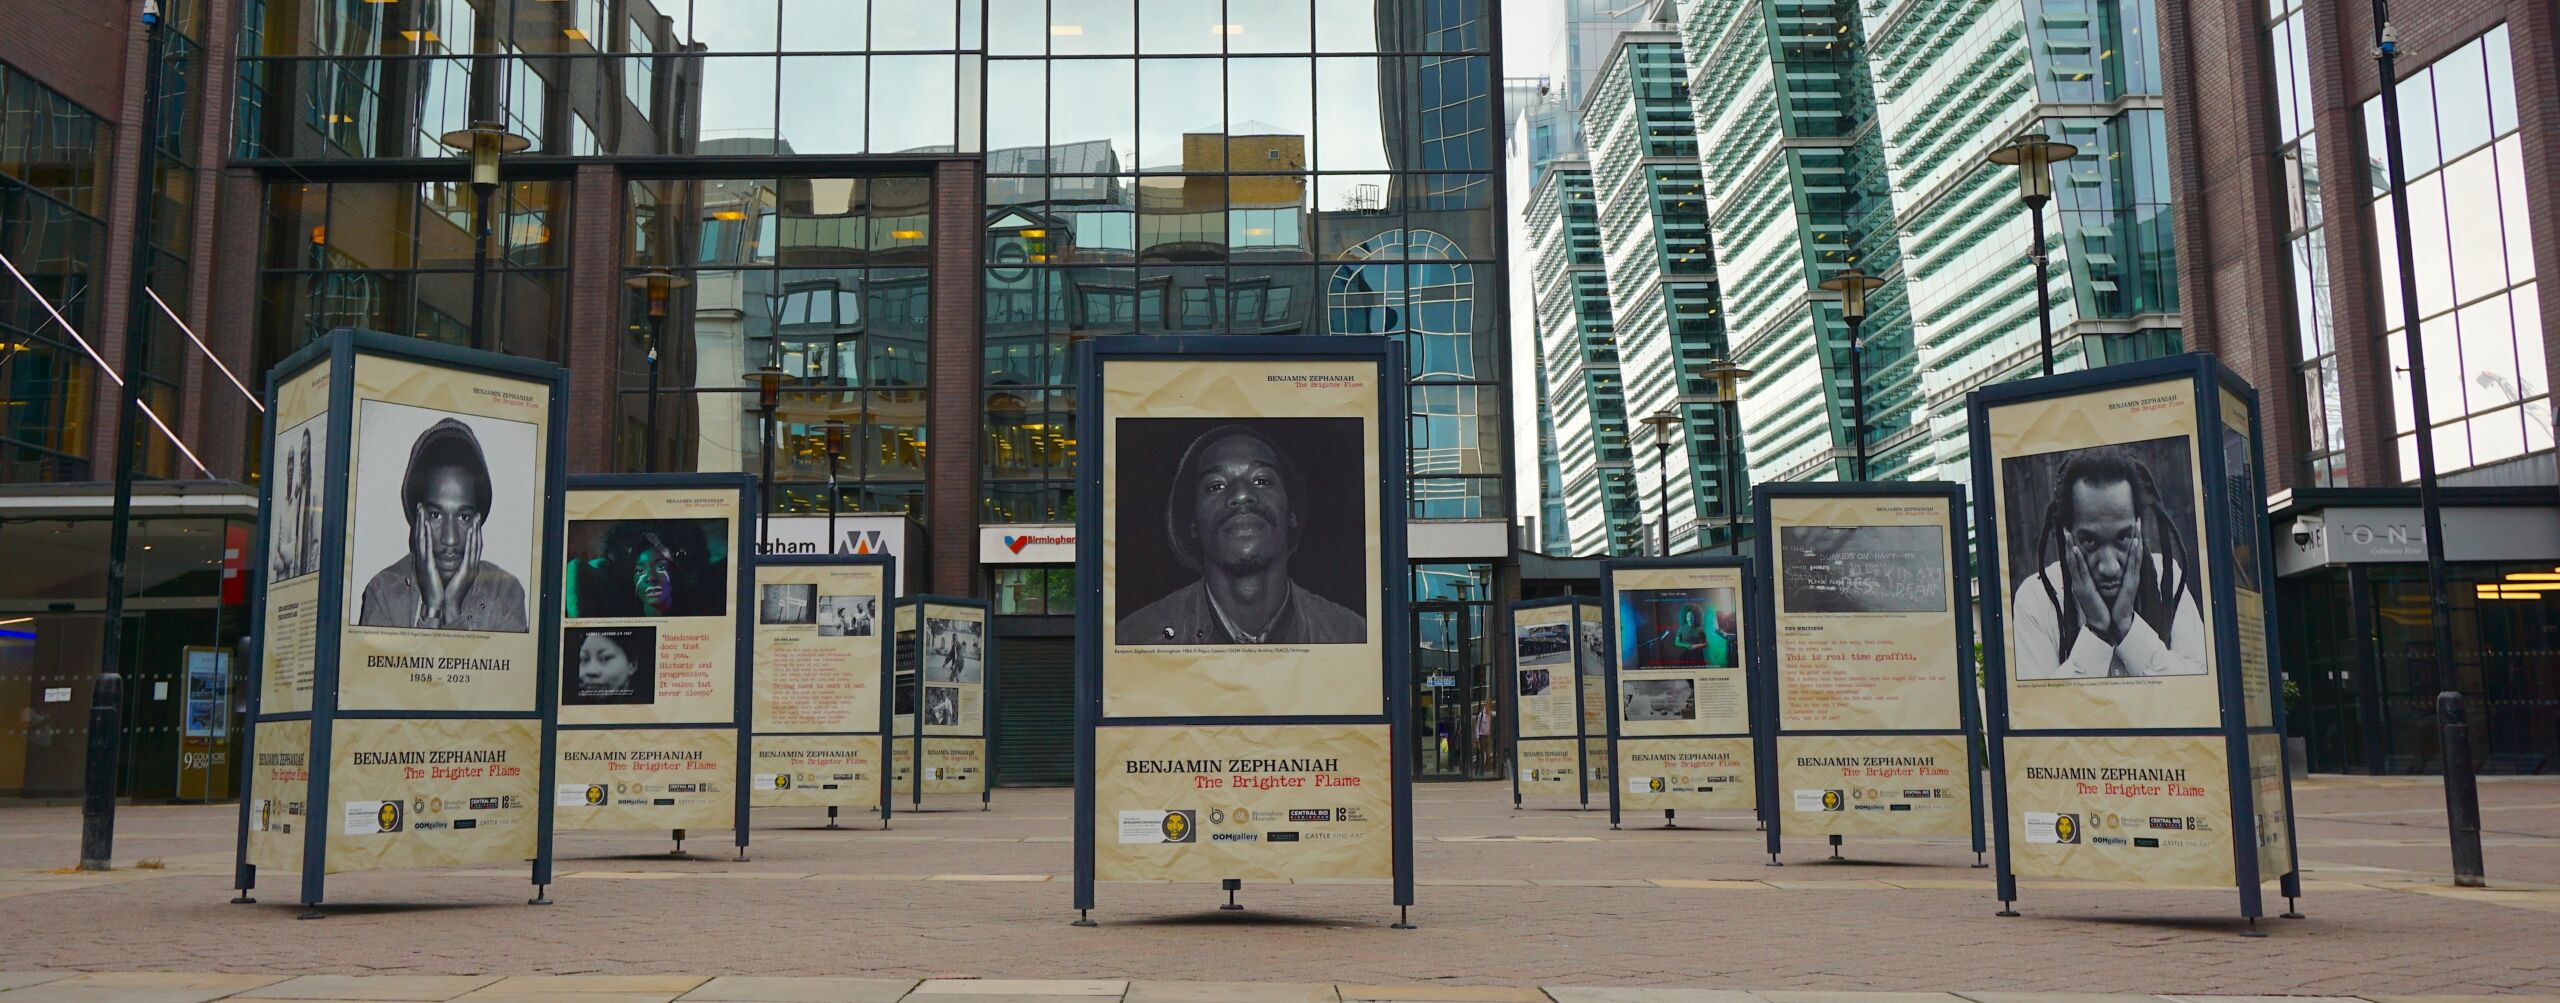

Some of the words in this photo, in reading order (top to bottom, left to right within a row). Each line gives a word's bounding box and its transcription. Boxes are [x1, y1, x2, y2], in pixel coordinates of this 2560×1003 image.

[473, 387, 501, 397] BENJAMIN
[502, 392, 534, 402] ZEPHANIAH
[2108, 400, 2140, 410] BENJAMIN
[2140, 394, 2177, 405] ZEPHANIAH
[1785, 653, 1806, 661] This
[1826, 653, 1845, 661] real
[1852, 653, 1870, 661] time
[1876, 653, 1917, 661] graffiti.
[367, 655, 434, 669] BENJAMIN
[438, 658, 510, 671] ZEPHANIAH
[410, 673, 432, 683] 1958
[447, 674, 470, 683] 2023
[353, 751, 425, 765] BENJAMIN
[429, 750, 506, 763] ZEPHANIAH
[564, 751, 627, 761] BENJAMIN
[631, 751, 703, 760] ZEPHANIAH
[806, 750, 857, 758] ZEPHANIAH
[184, 752, 193, 769] 9
[808, 758, 841, 766] Brighter
[1680, 760, 1714, 768] Brighter
[1797, 757, 1859, 766] BENJAMIN
[1863, 757, 1934, 766] ZEPHANIAH
[608, 761, 627, 771] The
[632, 761, 681, 772] Brighter
[686, 761, 717, 770] Flame
[1126, 760, 1222, 774] BENJAMIN
[1229, 758, 1339, 773] ZEPHANIAH
[404, 766, 425, 779] The
[431, 765, 484, 780] Brighter
[489, 764, 521, 776] Flame
[1841, 767, 1860, 776] The
[1866, 767, 1914, 777] Brighter
[1919, 767, 1950, 776] Flame
[2027, 767, 2096, 780] BENJAMIN
[2100, 768, 2186, 781] ZEPHANIAH
[1195, 775, 1223, 789] The
[1232, 775, 1306, 790] Brighter
[1314, 774, 1360, 788] Flame
[2076, 782, 2098, 795] The
[2105, 783, 2160, 798] Brighter
[2168, 784, 2205, 797] Flame
[414, 821, 448, 829] OOMgallery
[1212, 833, 1258, 841] OOMgallery
[2092, 836, 2127, 845] OOMgallery
